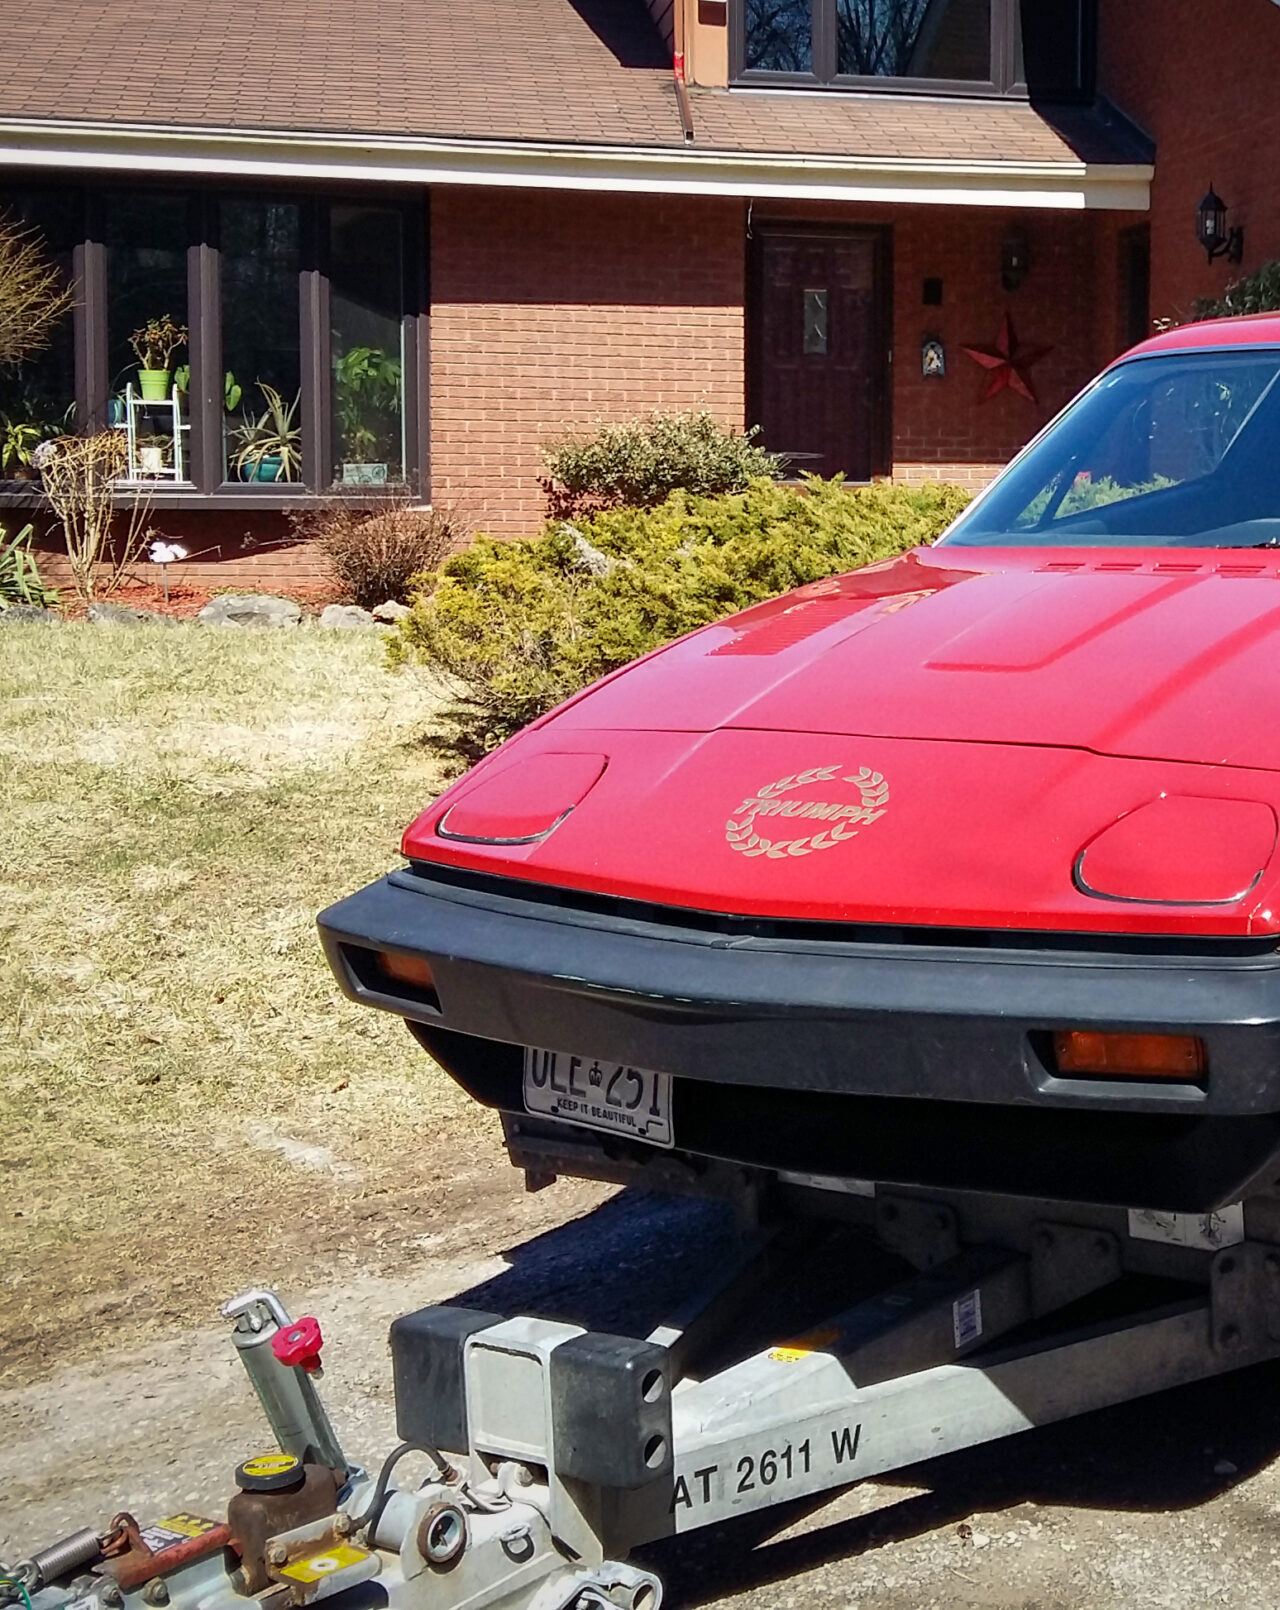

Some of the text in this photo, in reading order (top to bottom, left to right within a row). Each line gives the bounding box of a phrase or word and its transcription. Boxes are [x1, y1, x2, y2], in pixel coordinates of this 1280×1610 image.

[733, 798, 888, 825] TRIUMPH
[556, 1097, 638, 1127] KEEP IT BEAUTIFUL
[669, 1424, 862, 1514] AT 2611 W
